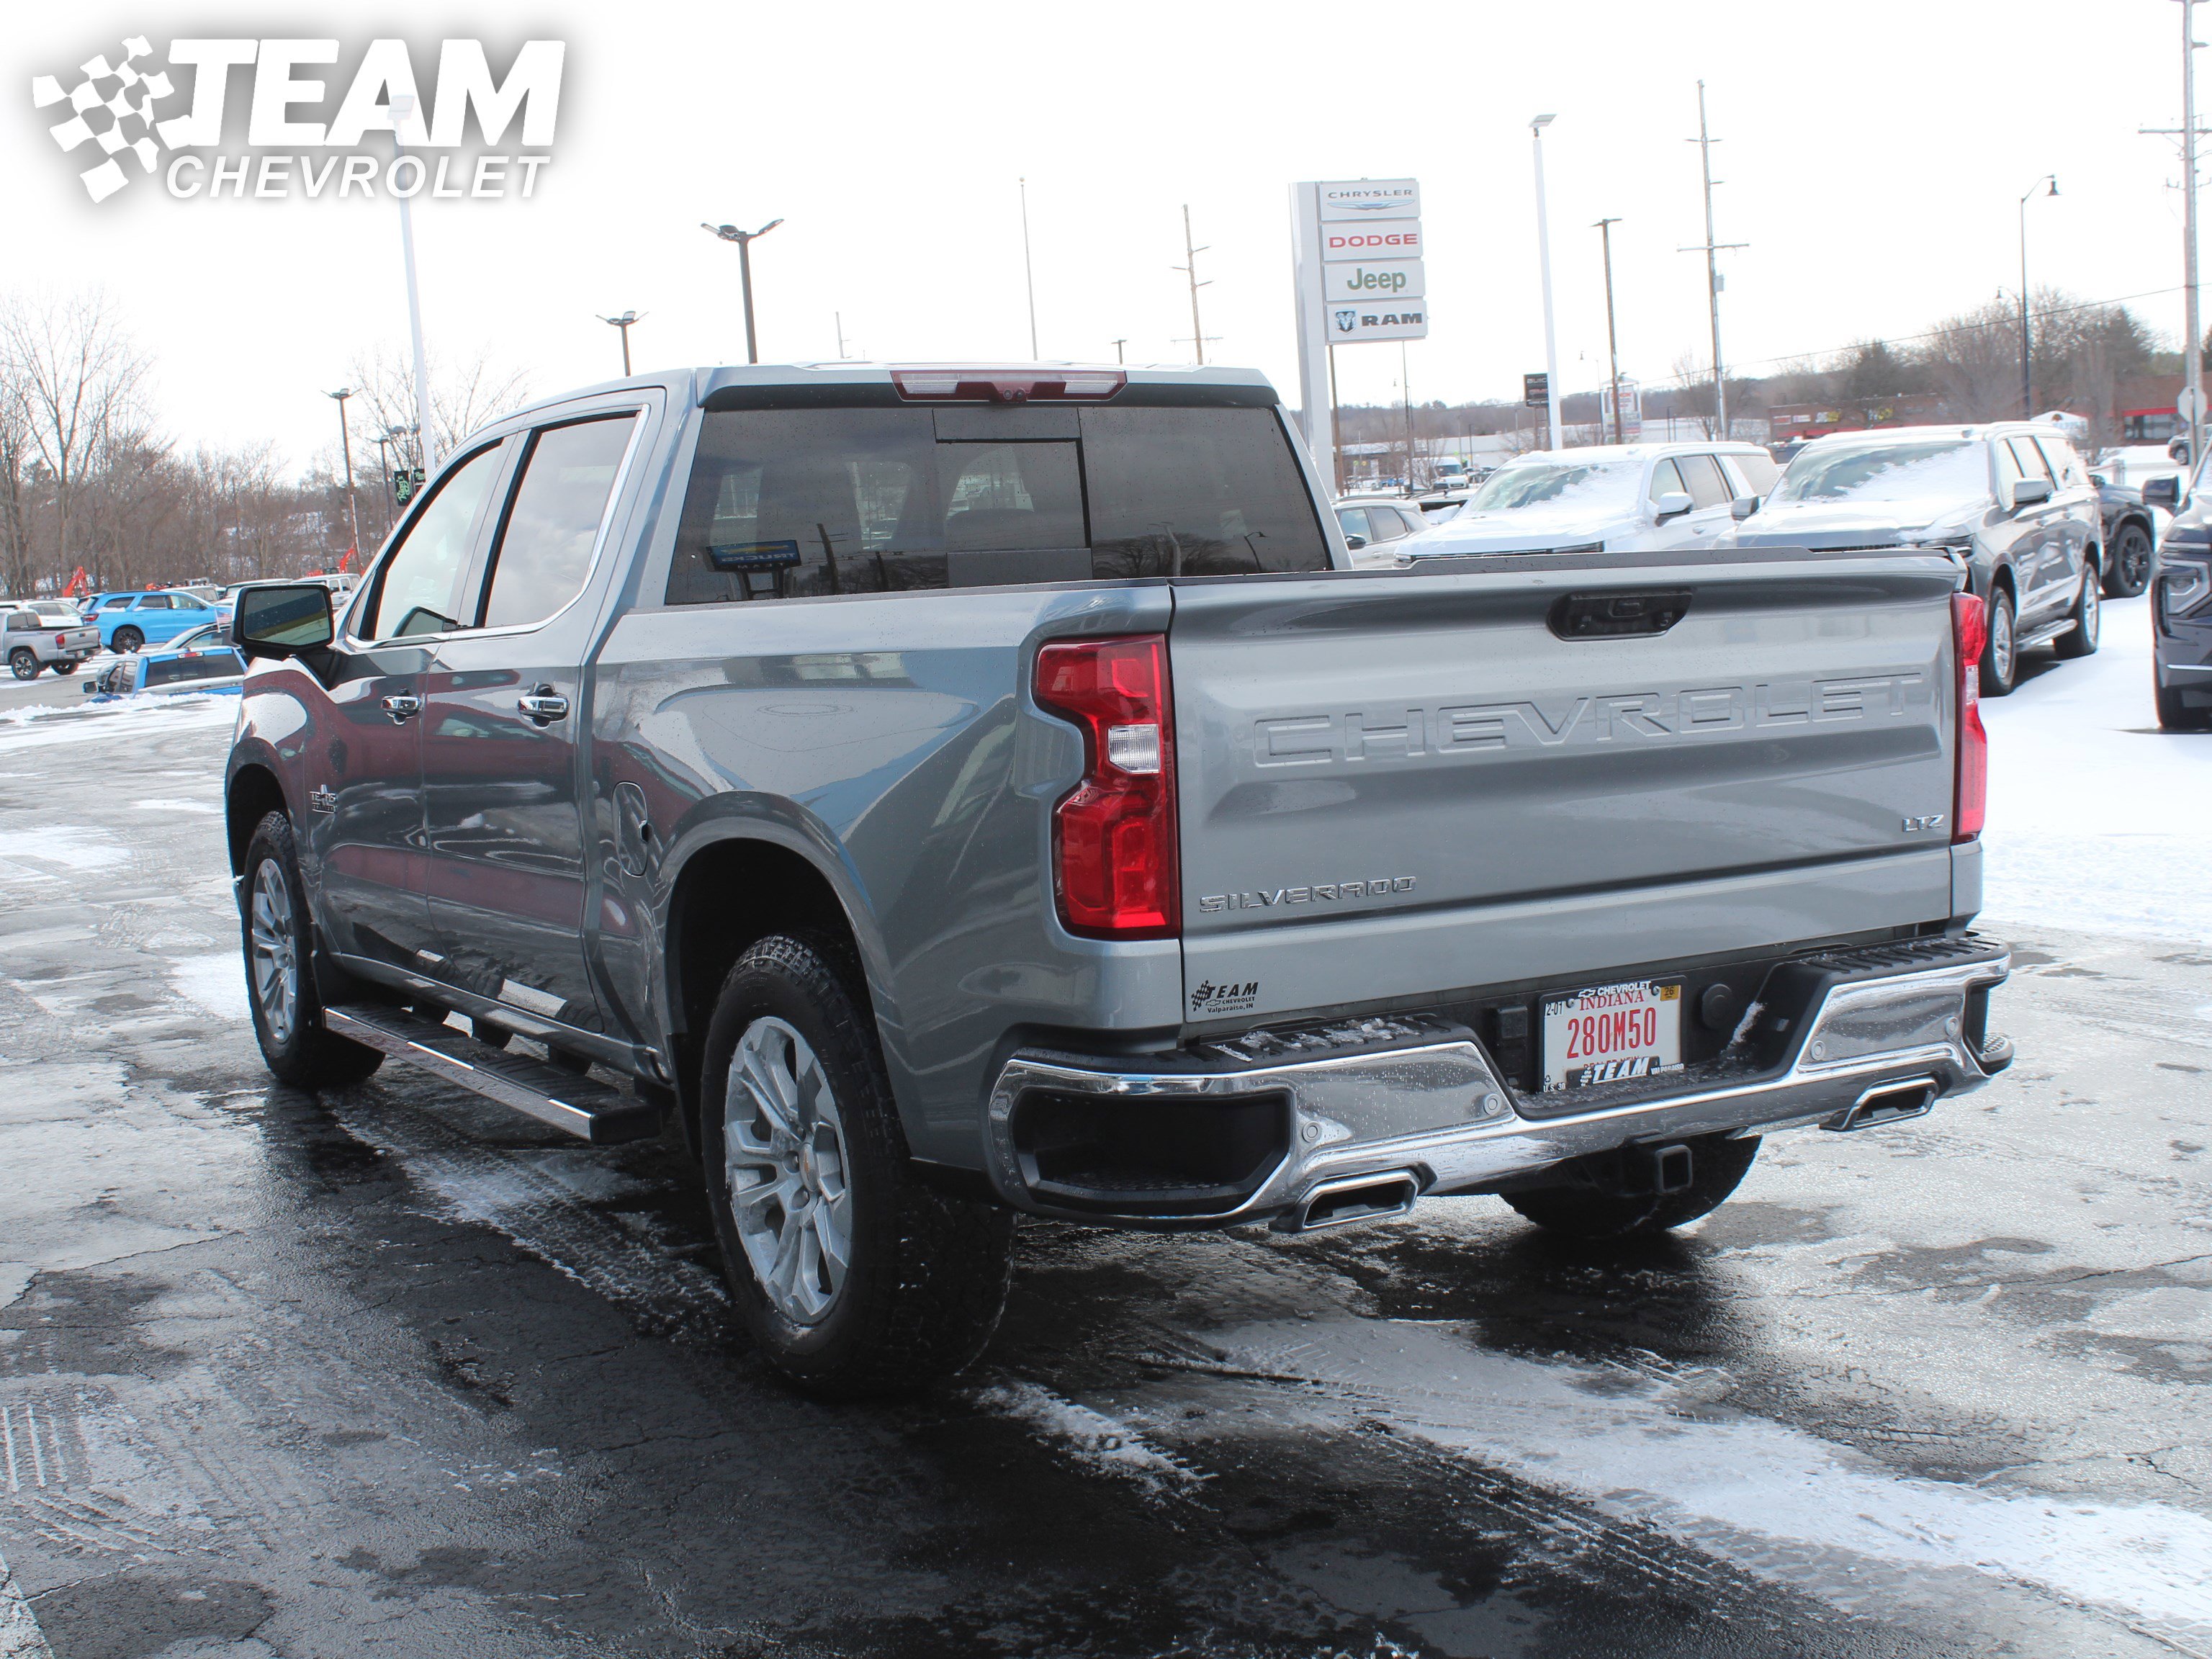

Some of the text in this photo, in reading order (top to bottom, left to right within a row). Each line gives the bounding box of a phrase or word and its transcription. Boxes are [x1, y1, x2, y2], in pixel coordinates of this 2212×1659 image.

[1328, 189, 1413, 199] CHRYSLER
[1329, 234, 1418, 248] DODGE
[1346, 268, 1406, 293] Jeep
[1362, 313, 1423, 326] RAM
[1253, 673, 1922, 768] CHEVROLET
[1902, 814, 1944, 832] LTZ
[1200, 876, 1416, 913] SILVERADO
[1206, 981, 1259, 999] TEAM
[1597, 981, 1651, 996] CHEVROLET
[1665, 986, 1674, 996] 26
[1208, 1004, 1245, 1013] Valparaiso,
[1579, 990, 1645, 1011] INDIANA
[1567, 1007, 1656, 1059] 280M50
[1593, 1057, 1650, 1082] TEAM
